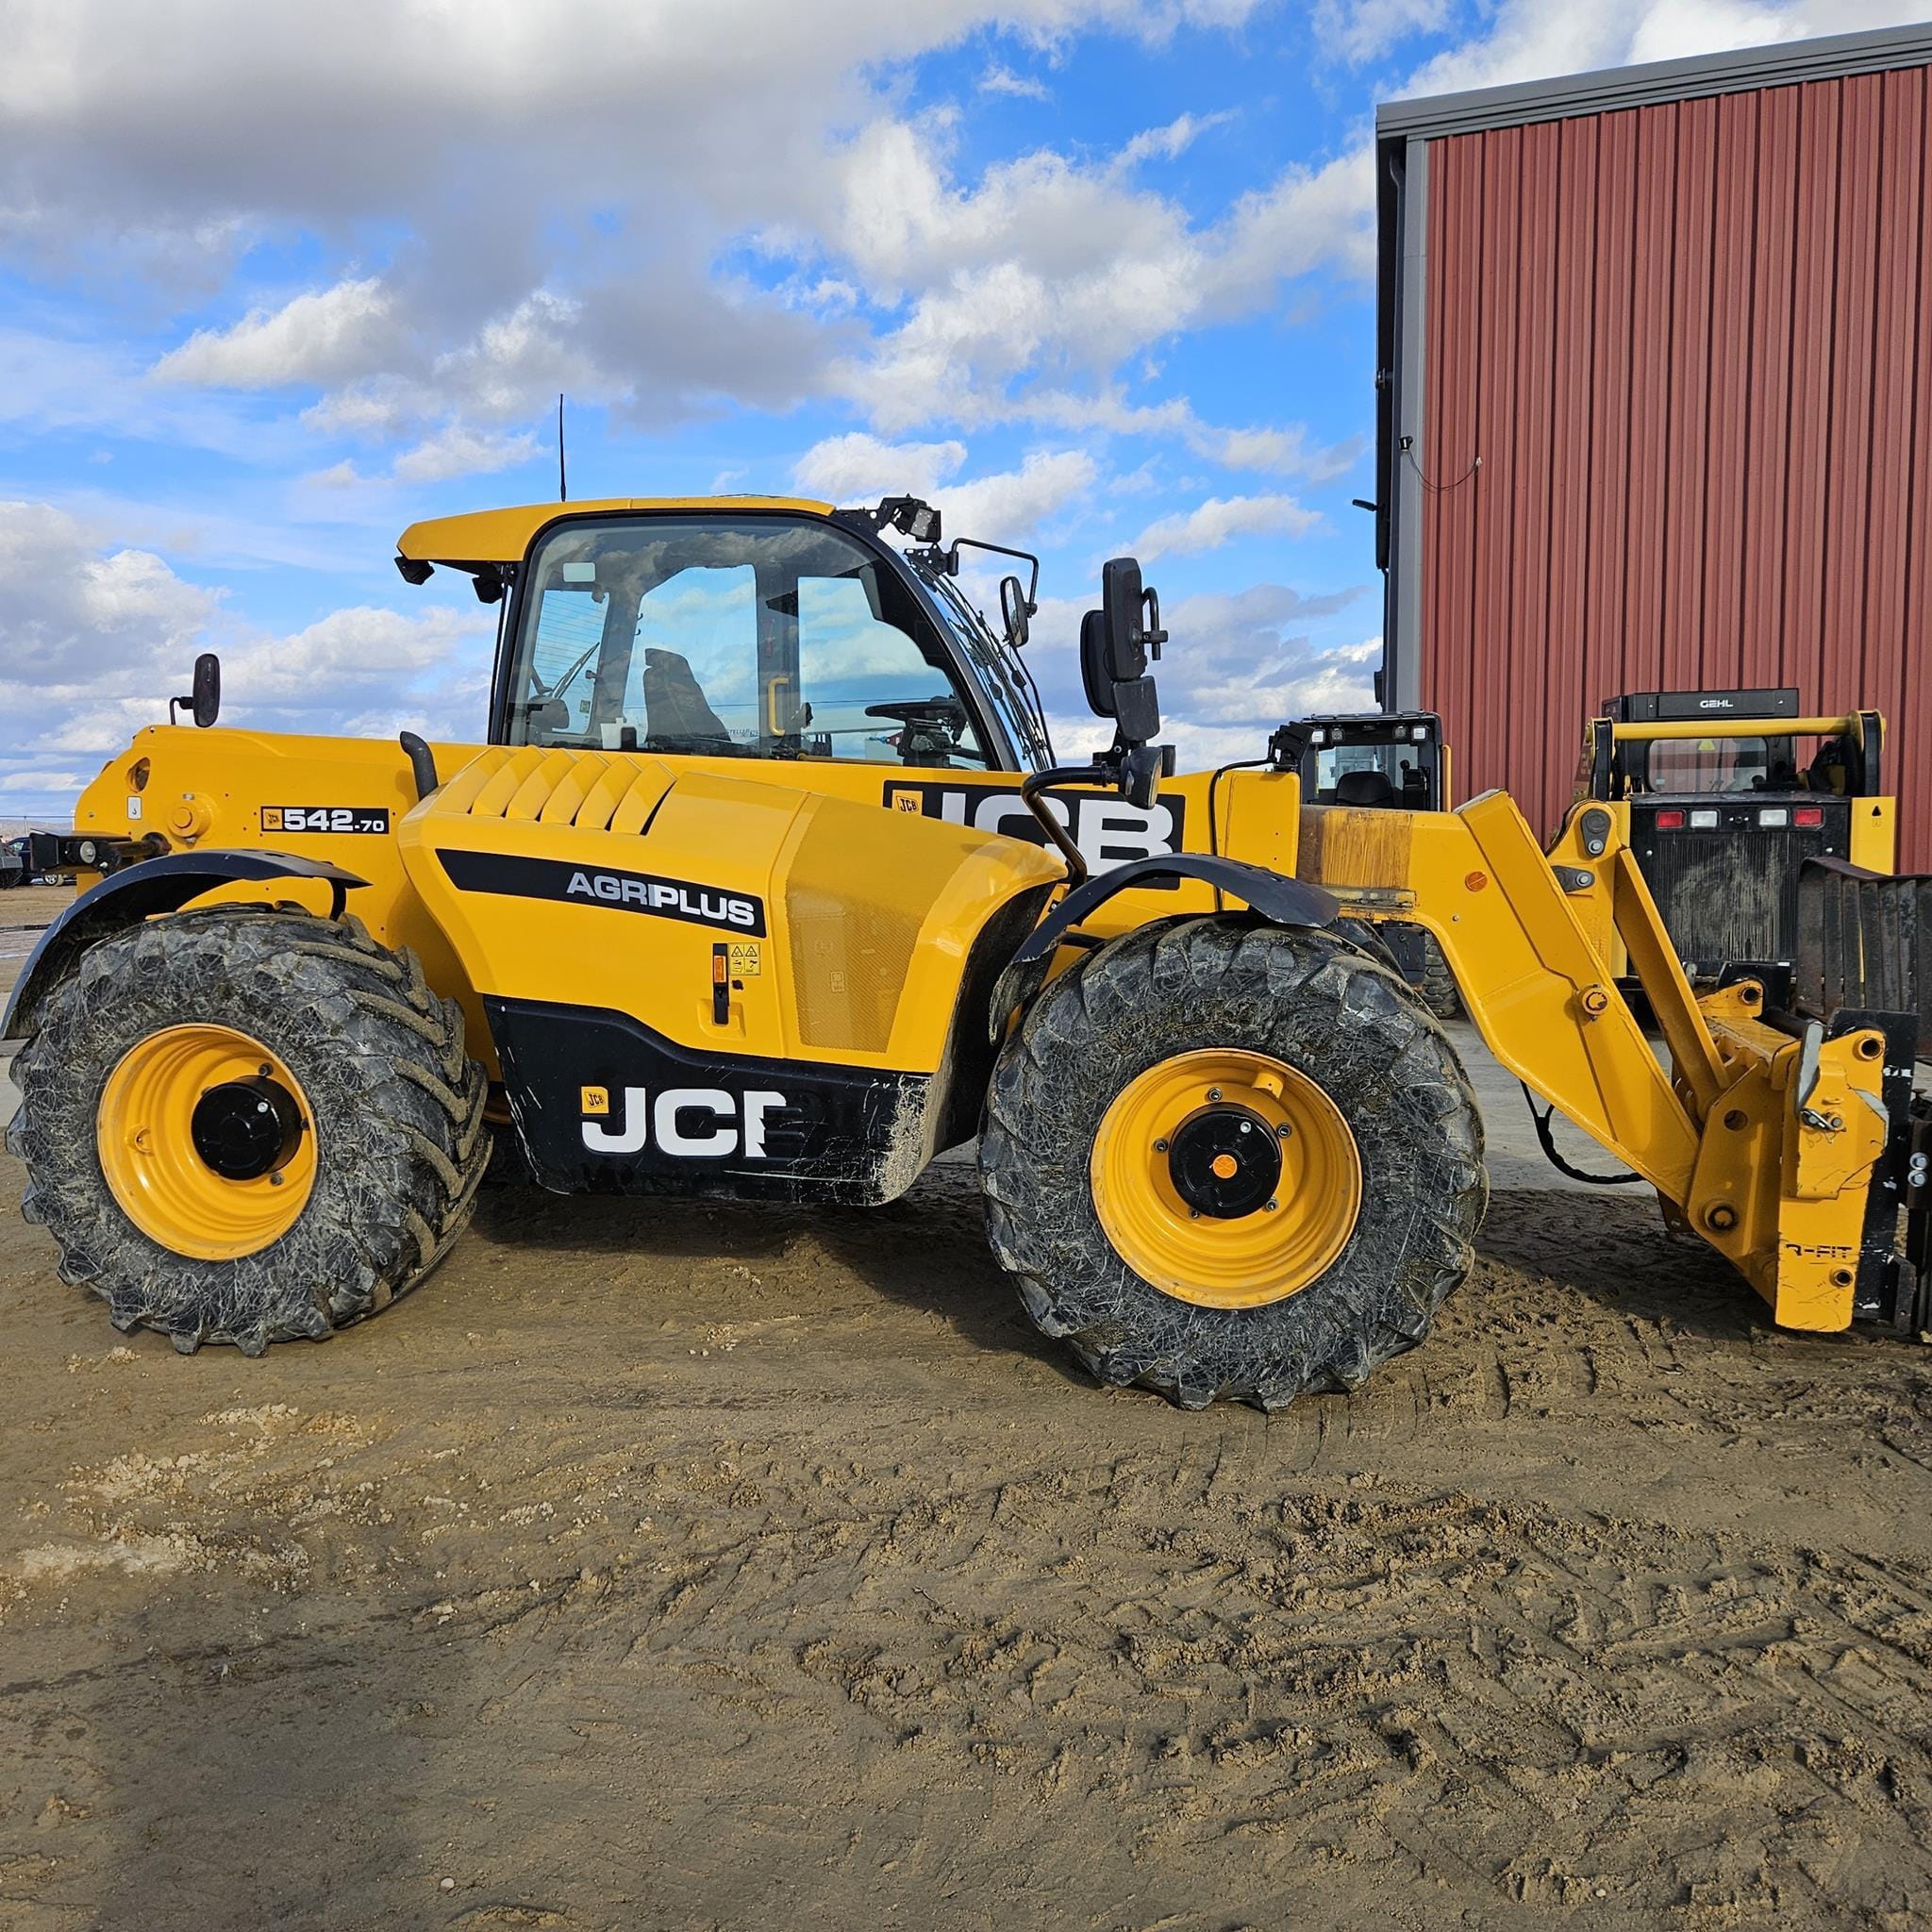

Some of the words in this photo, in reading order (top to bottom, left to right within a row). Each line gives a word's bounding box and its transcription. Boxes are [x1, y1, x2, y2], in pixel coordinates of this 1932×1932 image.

[1699, 699, 1734, 708] GEHL
[900, 797, 918, 811] JCB
[284, 808, 385, 832] 542-70
[566, 872, 755, 926] AGRIPLUS
[588, 1091, 605, 1108] JCB
